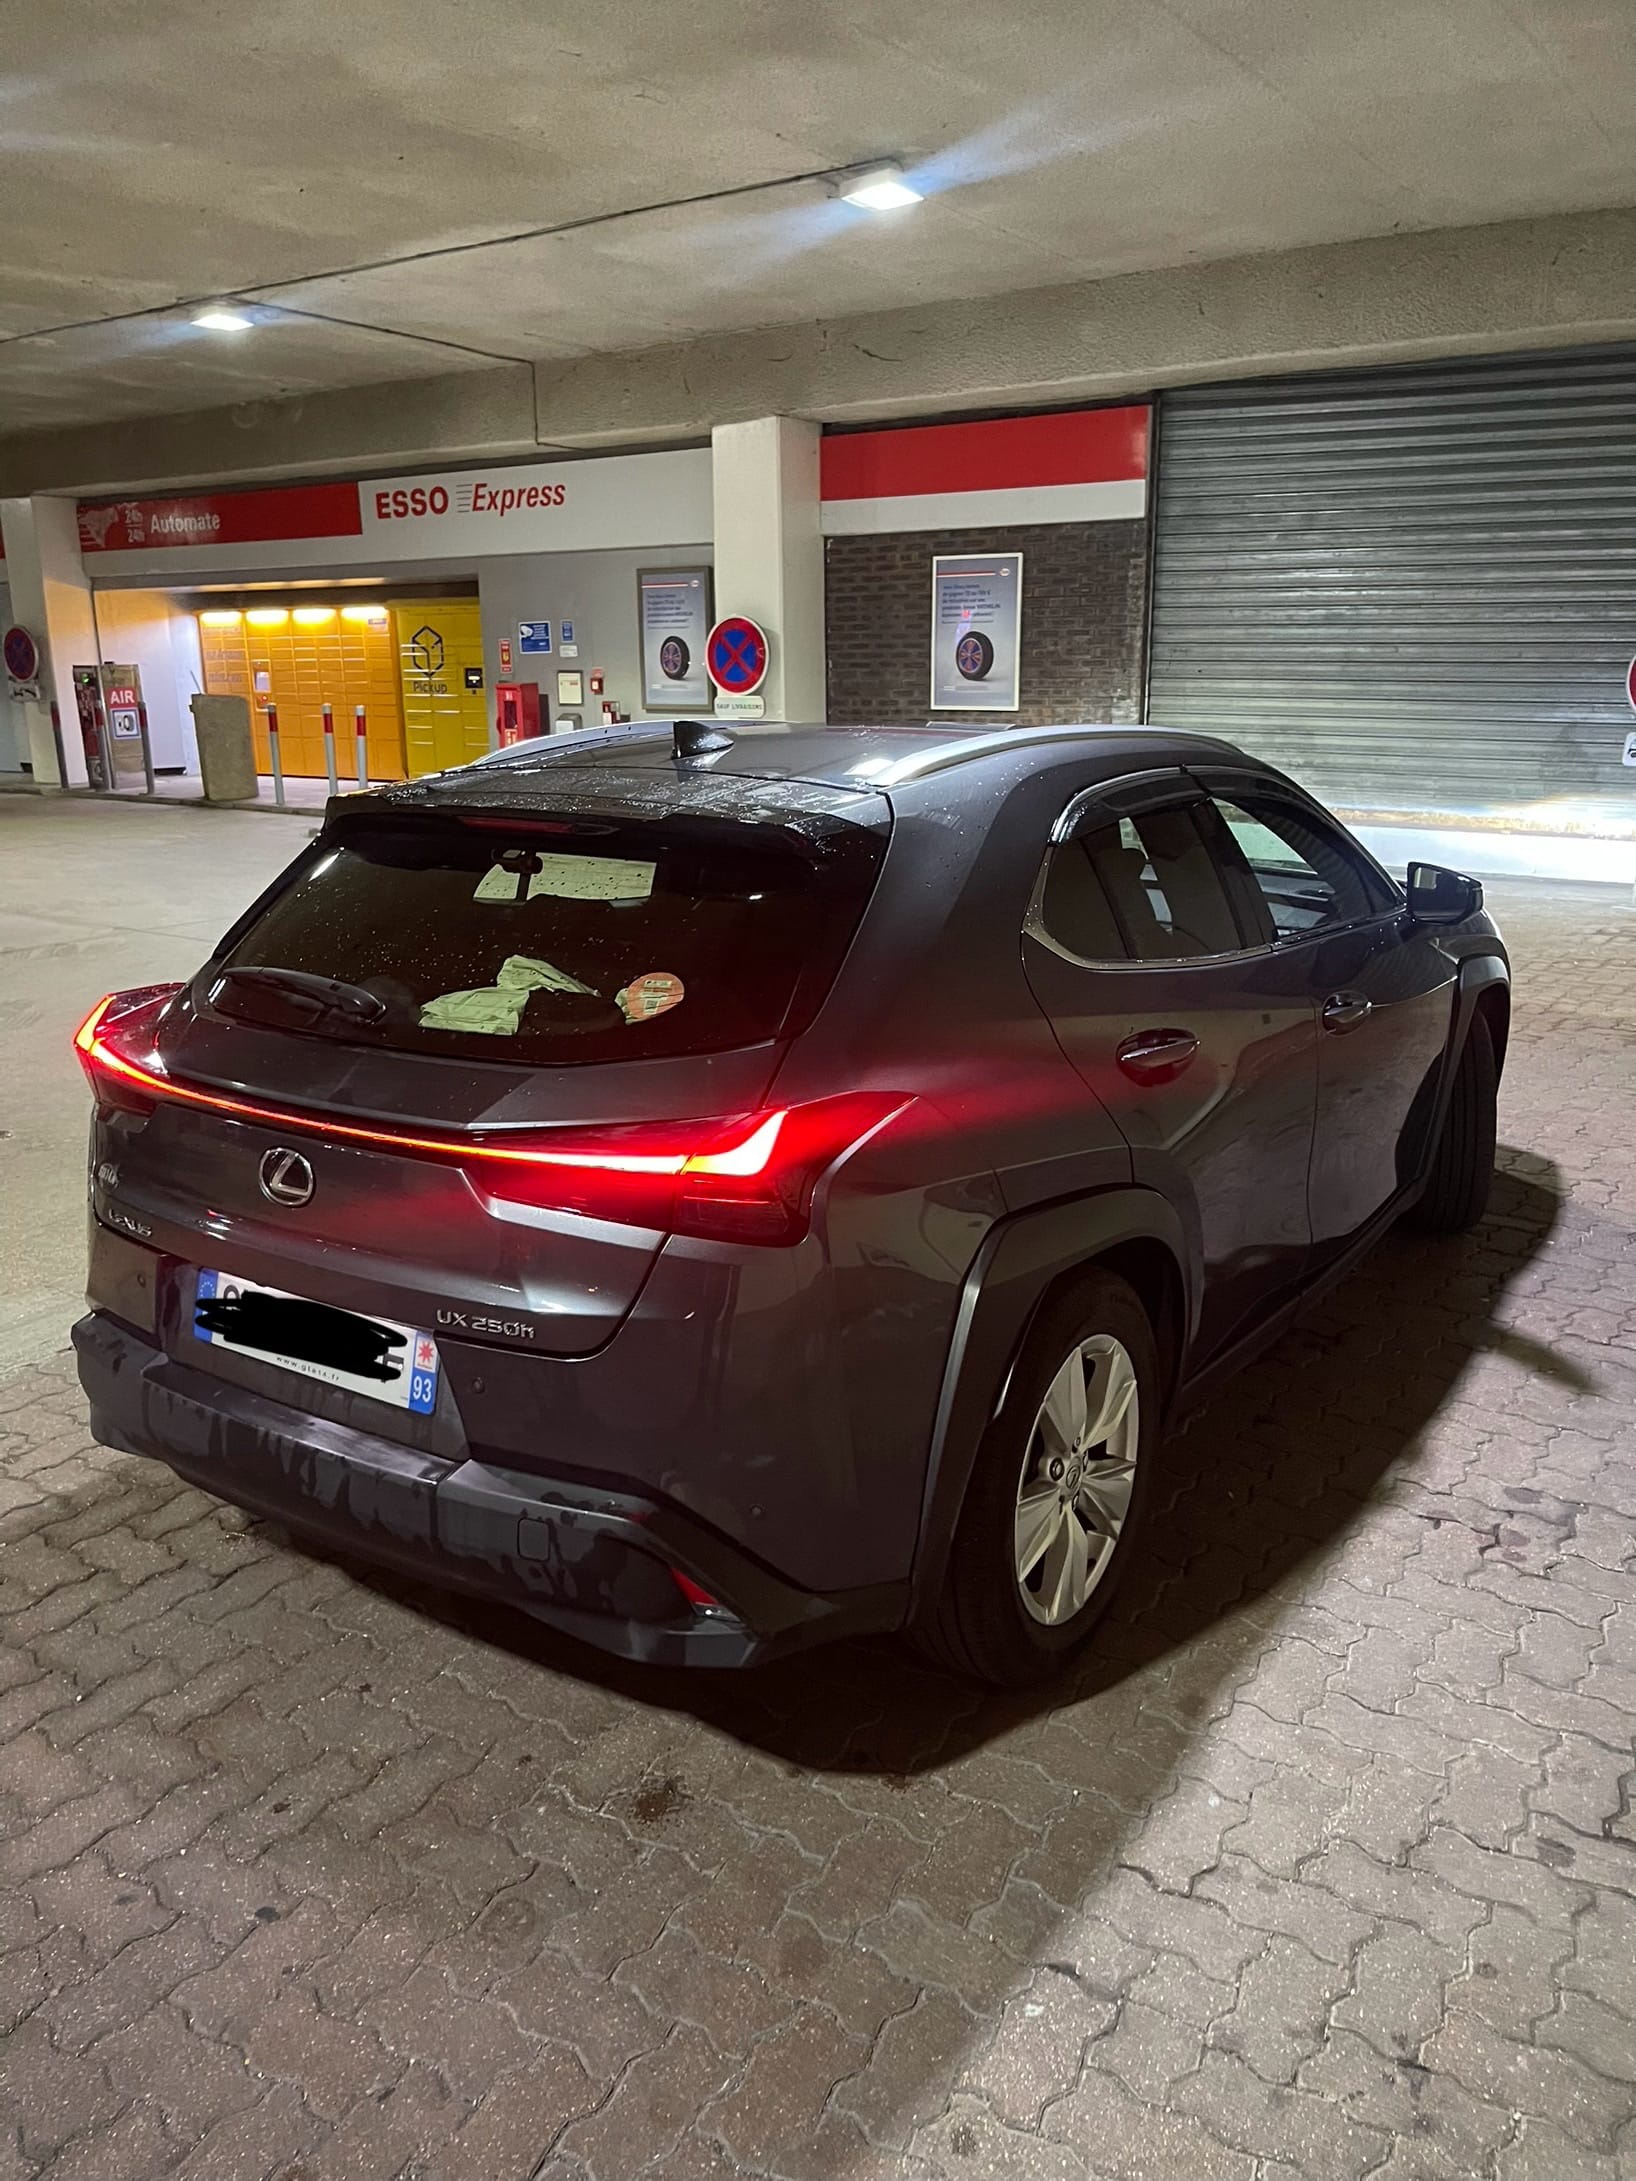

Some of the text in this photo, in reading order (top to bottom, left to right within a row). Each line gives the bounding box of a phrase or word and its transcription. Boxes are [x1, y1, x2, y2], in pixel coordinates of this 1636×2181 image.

[375, 483, 566, 519] ESSO Express
[151, 512, 221, 534] Automate
[110, 690, 135, 705] AIR
[436, 1309, 535, 1339] UX 250h
[412, 1375, 433, 1403] 93
